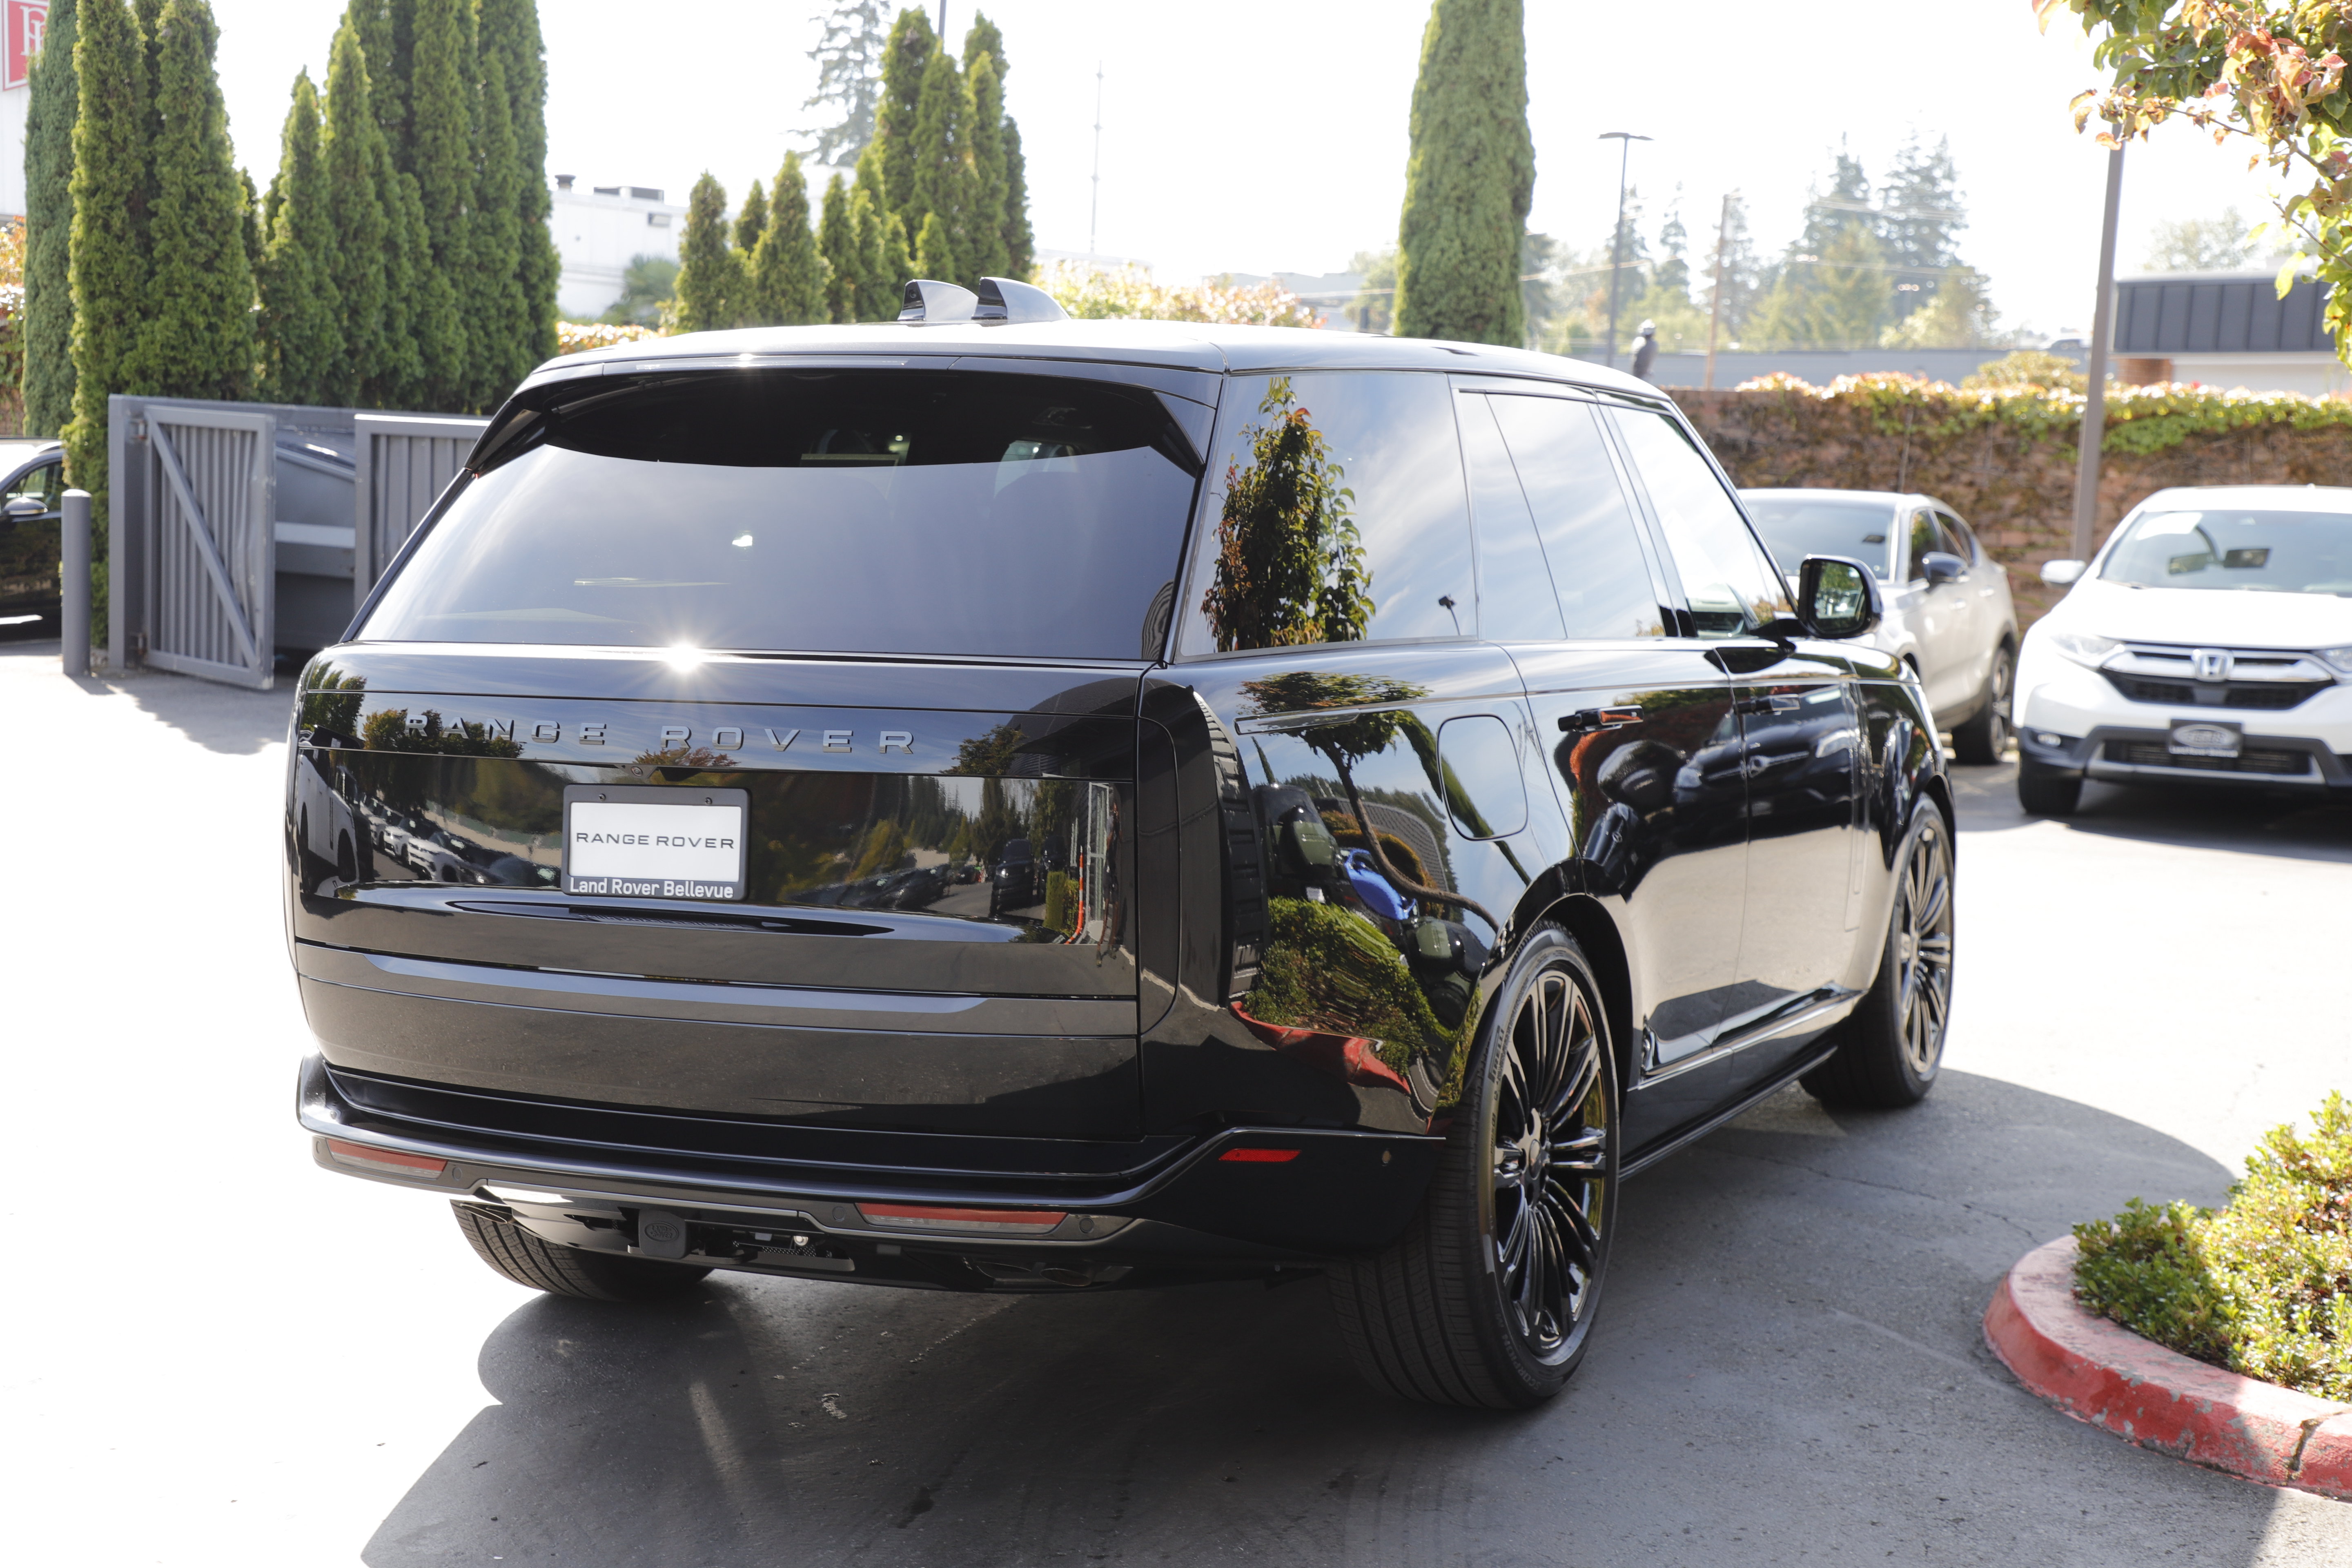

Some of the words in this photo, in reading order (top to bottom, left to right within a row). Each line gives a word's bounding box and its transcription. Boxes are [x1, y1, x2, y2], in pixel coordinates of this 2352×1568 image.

[404, 714, 607, 746] RANGE
[660, 725, 914, 755] ROVER
[576, 832, 650, 845] RANGE
[656, 835, 735, 849] ROVER
[570, 877, 608, 894] Land
[611, 878, 660, 896] Rover
[663, 880, 734, 898] Bellevue
